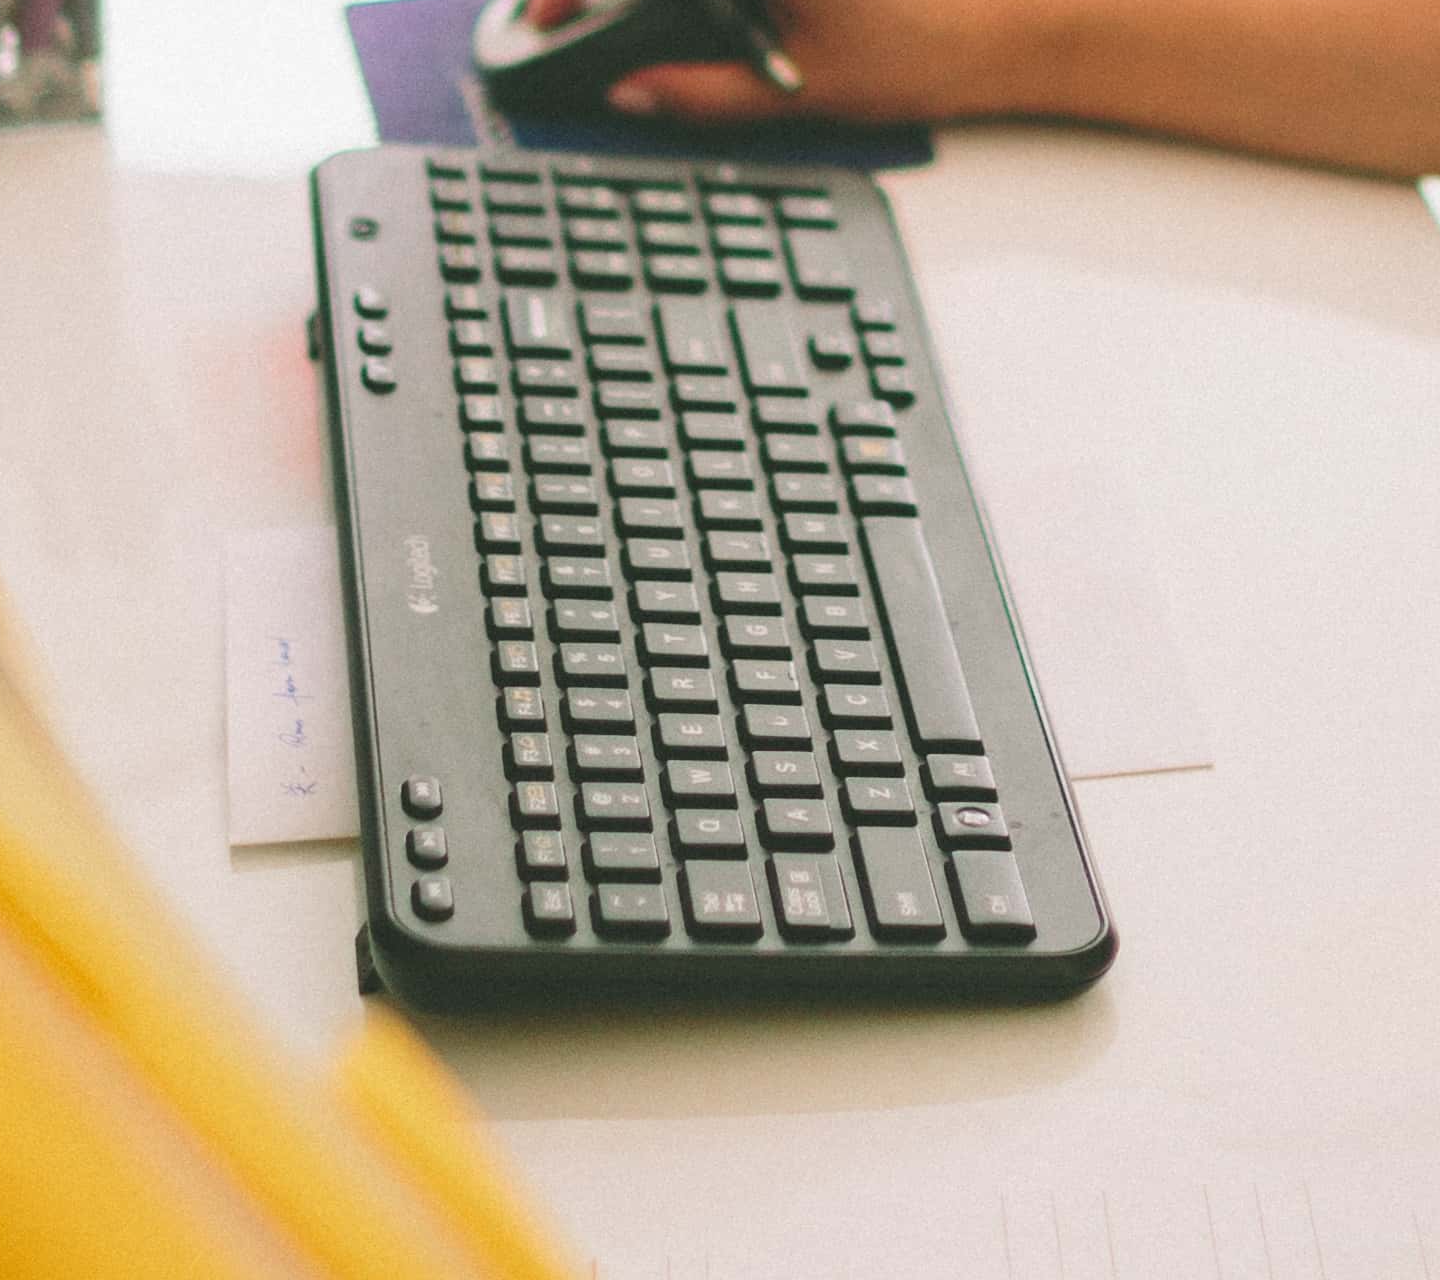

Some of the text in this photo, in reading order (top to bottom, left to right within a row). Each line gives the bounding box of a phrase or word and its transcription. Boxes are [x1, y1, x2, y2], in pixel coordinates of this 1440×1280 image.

[632, 466, 654, 477] O
[649, 548, 669, 558] U
[406, 535, 439, 589] Logitech
[736, 582, 758, 592] H
[656, 591, 676, 600] Y
[825, 606, 846, 616] B
[746, 624, 768, 635] G
[664, 634, 684, 643] T
[598, 653, 616, 662] 5
[835, 650, 856, 660] V
[511, 656, 528, 668] F5
[756, 671, 776, 679] F
[672, 678, 694, 689] R
[609, 699, 622, 708] 4
[846, 695, 868, 705] C
[518, 703, 534, 715] F4
[681, 724, 703, 734] E
[859, 740, 878, 750] X
[523, 749, 540, 762] F3
[614, 747, 631, 756] 3
[776, 763, 796, 772] S
[688, 769, 712, 784] W
[870, 788, 890, 798] Z
[528, 795, 547, 809] F2
[593, 793, 611, 805] @
[622, 794, 640, 804] 2
[788, 808, 809, 821] A
[699, 818, 720, 832] Q
